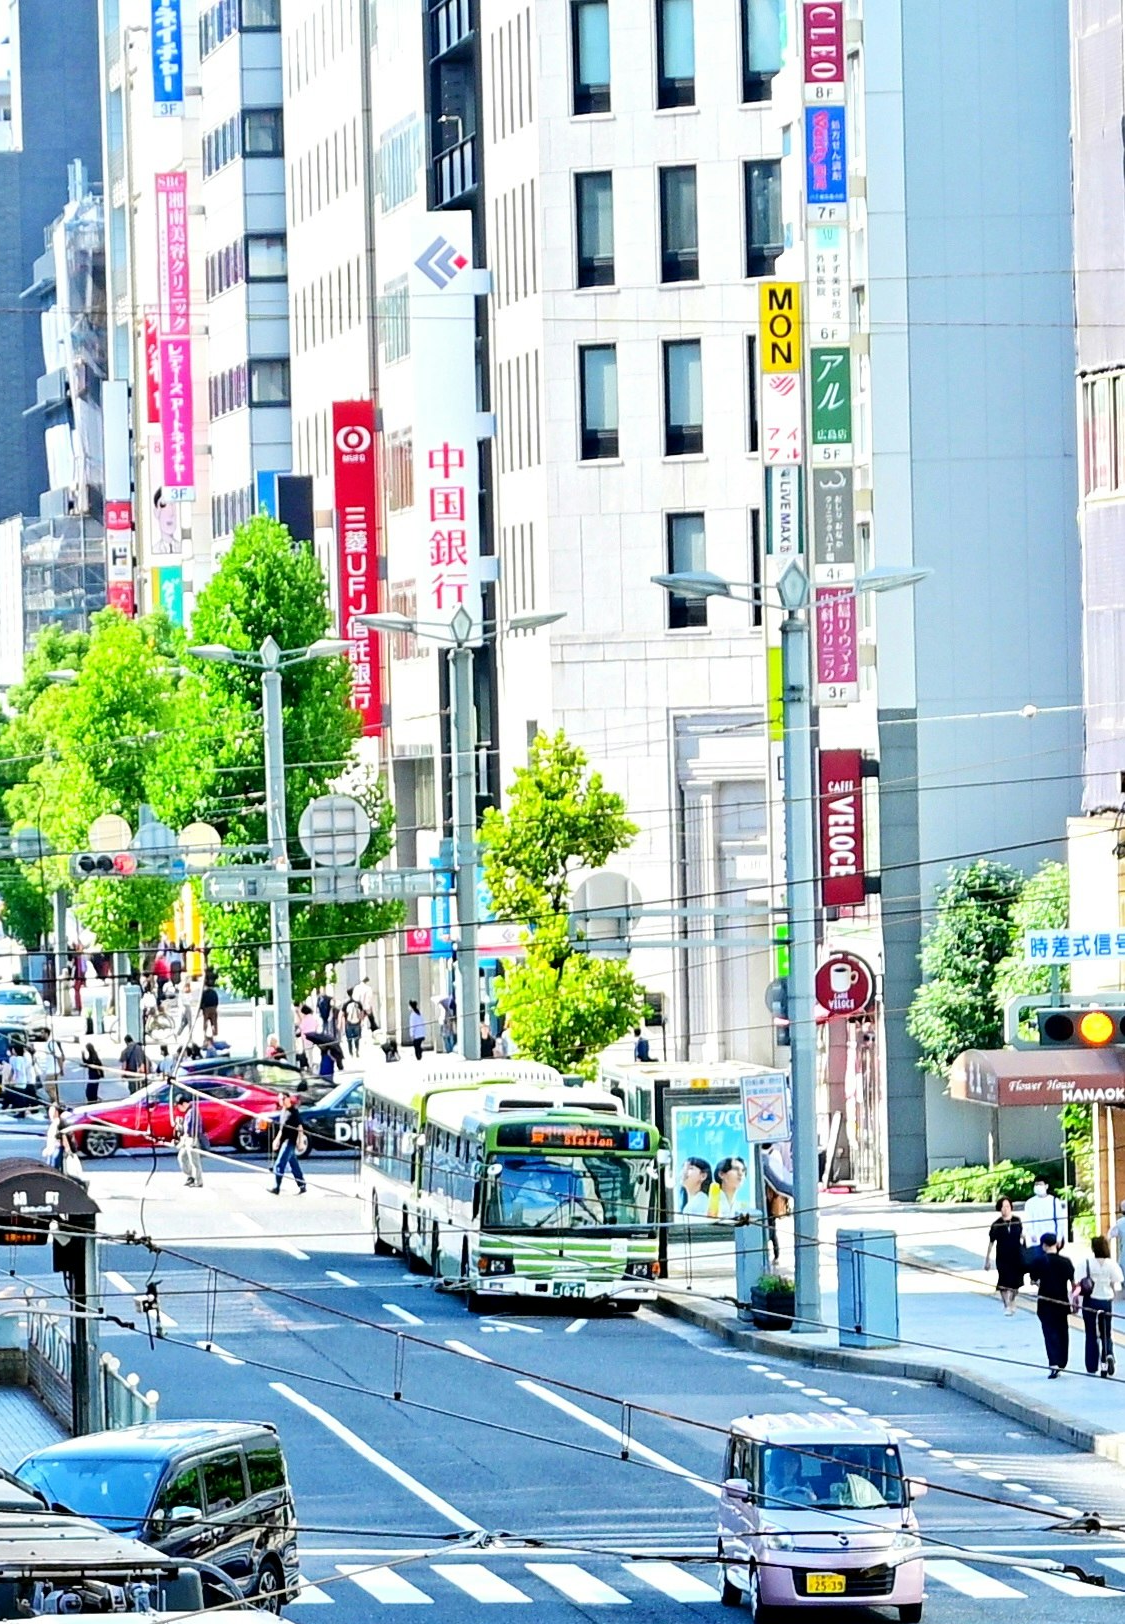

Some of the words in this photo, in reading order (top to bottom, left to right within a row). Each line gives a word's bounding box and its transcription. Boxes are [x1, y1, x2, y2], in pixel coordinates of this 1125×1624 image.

[155, 0, 179, 92] ネイチャー
[809, 6, 837, 79] CLEO
[815, 86, 834, 98] 8F
[160, 103, 178, 116] 3F
[818, 206, 836, 219] 7F
[168, 192, 187, 331] 湘南美容クリニック
[768, 288, 793, 364] MON
[820, 328, 838, 340] 6F
[817, 355, 845, 410] アル
[768, 428, 798, 440] アイ
[823, 448, 841, 460] 5F
[171, 488, 188, 500] 3F
[779, 481, 791, 510] LIVE
[428, 441, 469, 610] 中国銀行
[779, 513, 791, 543] MAX
[826, 567, 844, 579] 4F
[345, 506, 372, 710] 三菱UFJ信託銀行
[828, 686, 847, 699] 3F
[828, 795, 856, 878] VELOCE
[1009, 1080, 1043, 1092] Flower
[1046, 1079, 1076, 1091] House
[1062, 1087, 1125, 1102] HANAOK
